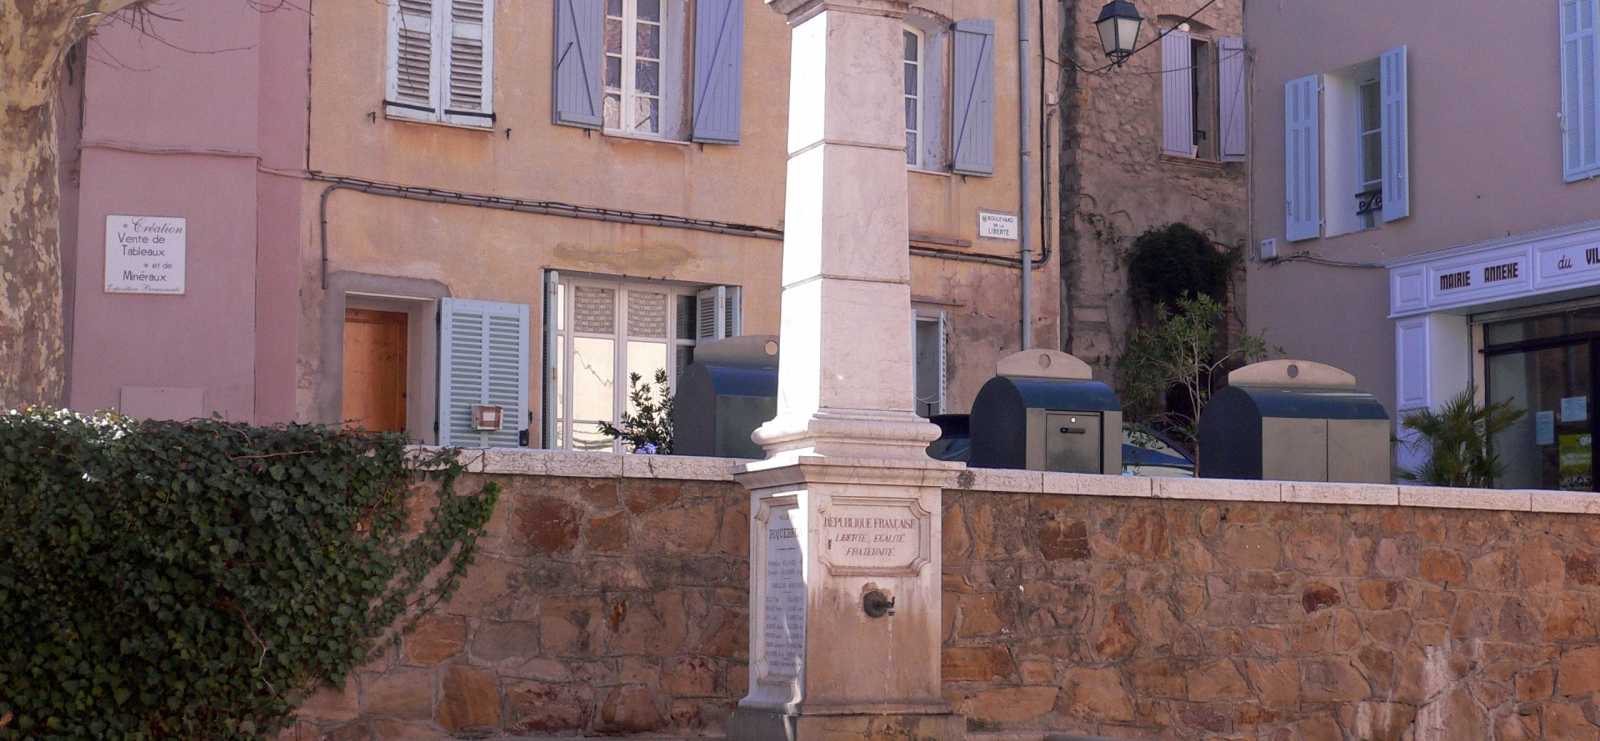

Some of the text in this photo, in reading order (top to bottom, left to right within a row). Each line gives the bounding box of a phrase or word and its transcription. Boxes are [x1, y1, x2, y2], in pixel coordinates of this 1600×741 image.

[132, 217, 183, 234] Création
[987, 215, 1013, 223] BOULEVARD
[118, 231, 166, 244] Vente de
[121, 244, 165, 256] Tableaux
[1558, 254, 1573, 270] du
[123, 269, 167, 282] Minéraux
[1440, 262, 1519, 291] MAIRIE ANNEXE
[873, 517, 916, 531] FRANÇAISE
